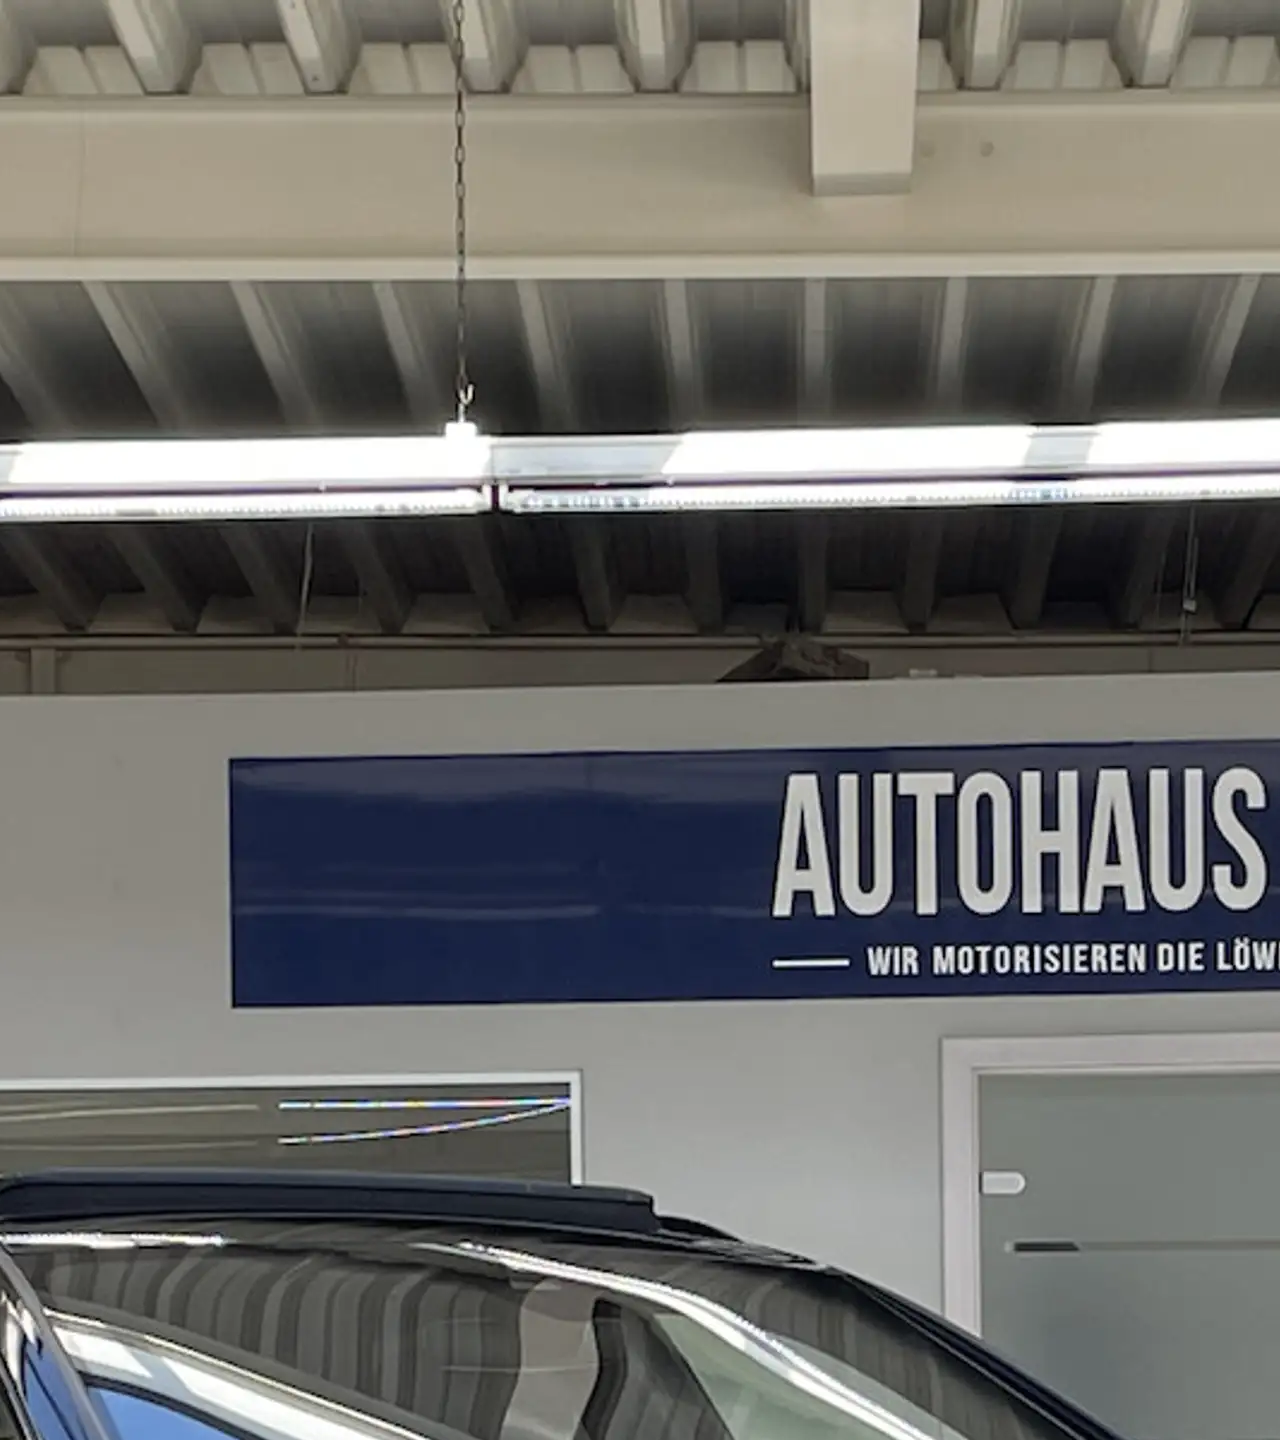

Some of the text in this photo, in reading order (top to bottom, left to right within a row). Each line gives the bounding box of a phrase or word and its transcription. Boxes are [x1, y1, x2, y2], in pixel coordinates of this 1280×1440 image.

[772, 768, 1267, 917] AUTOHAUS
[866, 946, 920, 976] WIR
[932, 943, 1147, 975] MOTORISIEREN
[1156, 941, 1206, 972] DIE
